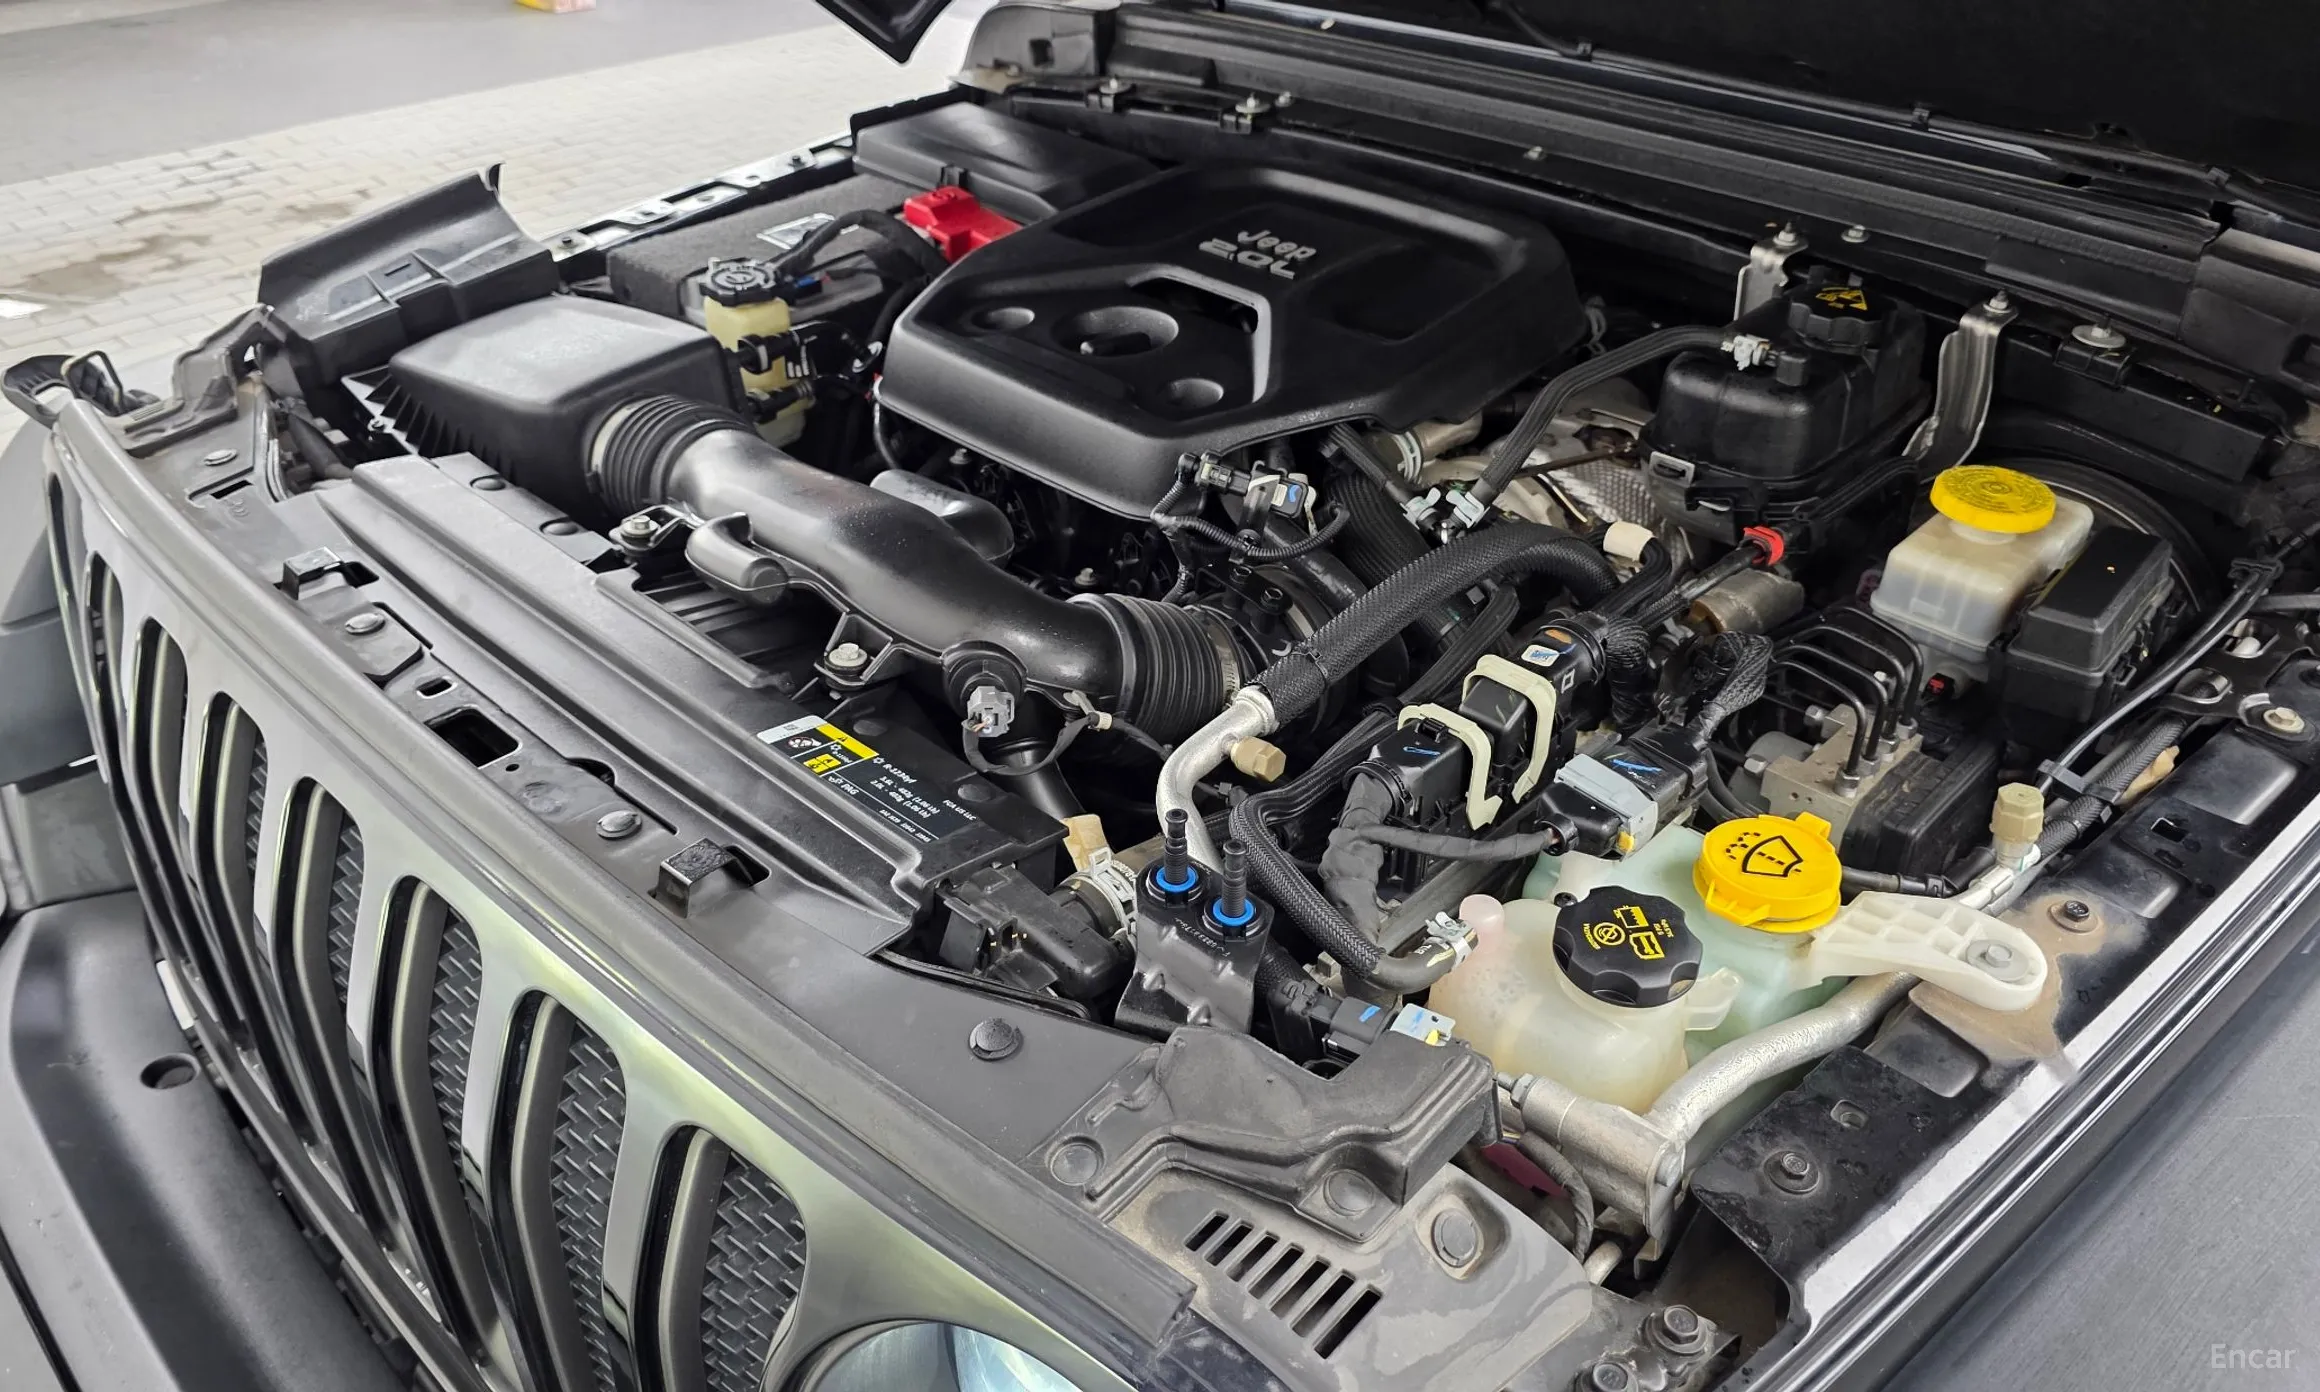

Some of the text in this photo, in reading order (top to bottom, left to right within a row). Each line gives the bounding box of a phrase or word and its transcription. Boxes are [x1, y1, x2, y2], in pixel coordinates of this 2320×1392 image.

[1199, 237, 1295, 279] 2.0L
[1237, 230, 1317, 261] Jeep
[954, 806, 967, 815] US
